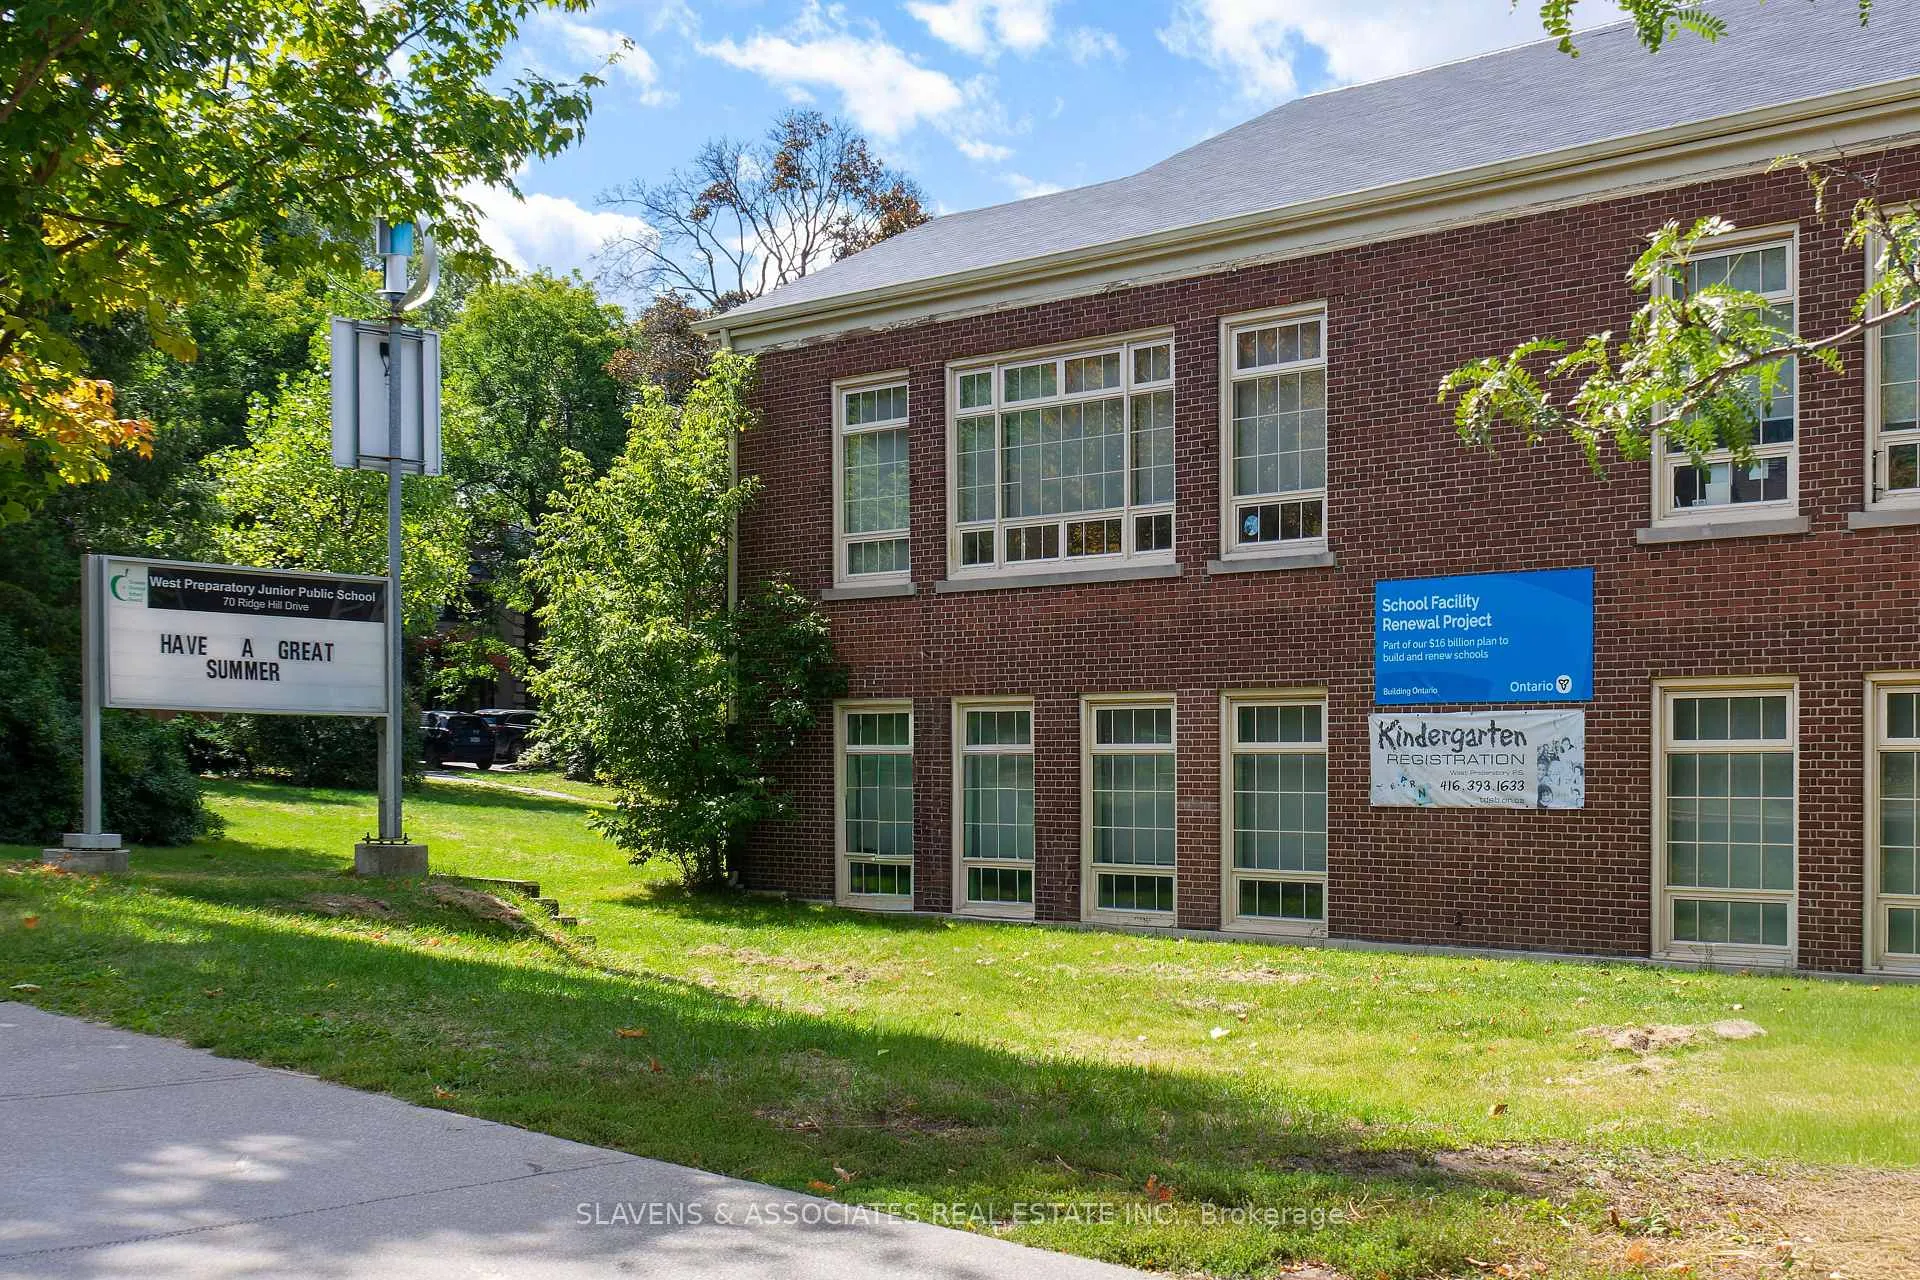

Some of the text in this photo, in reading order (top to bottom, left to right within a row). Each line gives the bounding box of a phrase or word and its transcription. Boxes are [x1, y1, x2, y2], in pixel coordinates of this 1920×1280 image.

[148, 575, 376, 603] West Preparatory Junior Public School
[223, 597, 310, 612] 70 Ridge Hill Drive
[1382, 593, 1480, 612] School Facility
[1382, 613, 1493, 632] Renewal Project
[160, 633, 335, 662] HAVE A GREAT
[1383, 636, 1510, 650] Part of our $16 billion plan to
[1383, 649, 1489, 662] build and renew schools
[206, 659, 281, 682] SUMMER
[1383, 686, 1438, 697] Building Ontario
[1510, 680, 1554, 692] Ontario
[1378, 719, 1528, 752] Kindergarten
[1386, 753, 1526, 766] REGISTRATION
[1440, 780, 1525, 792] 416.393.1633
